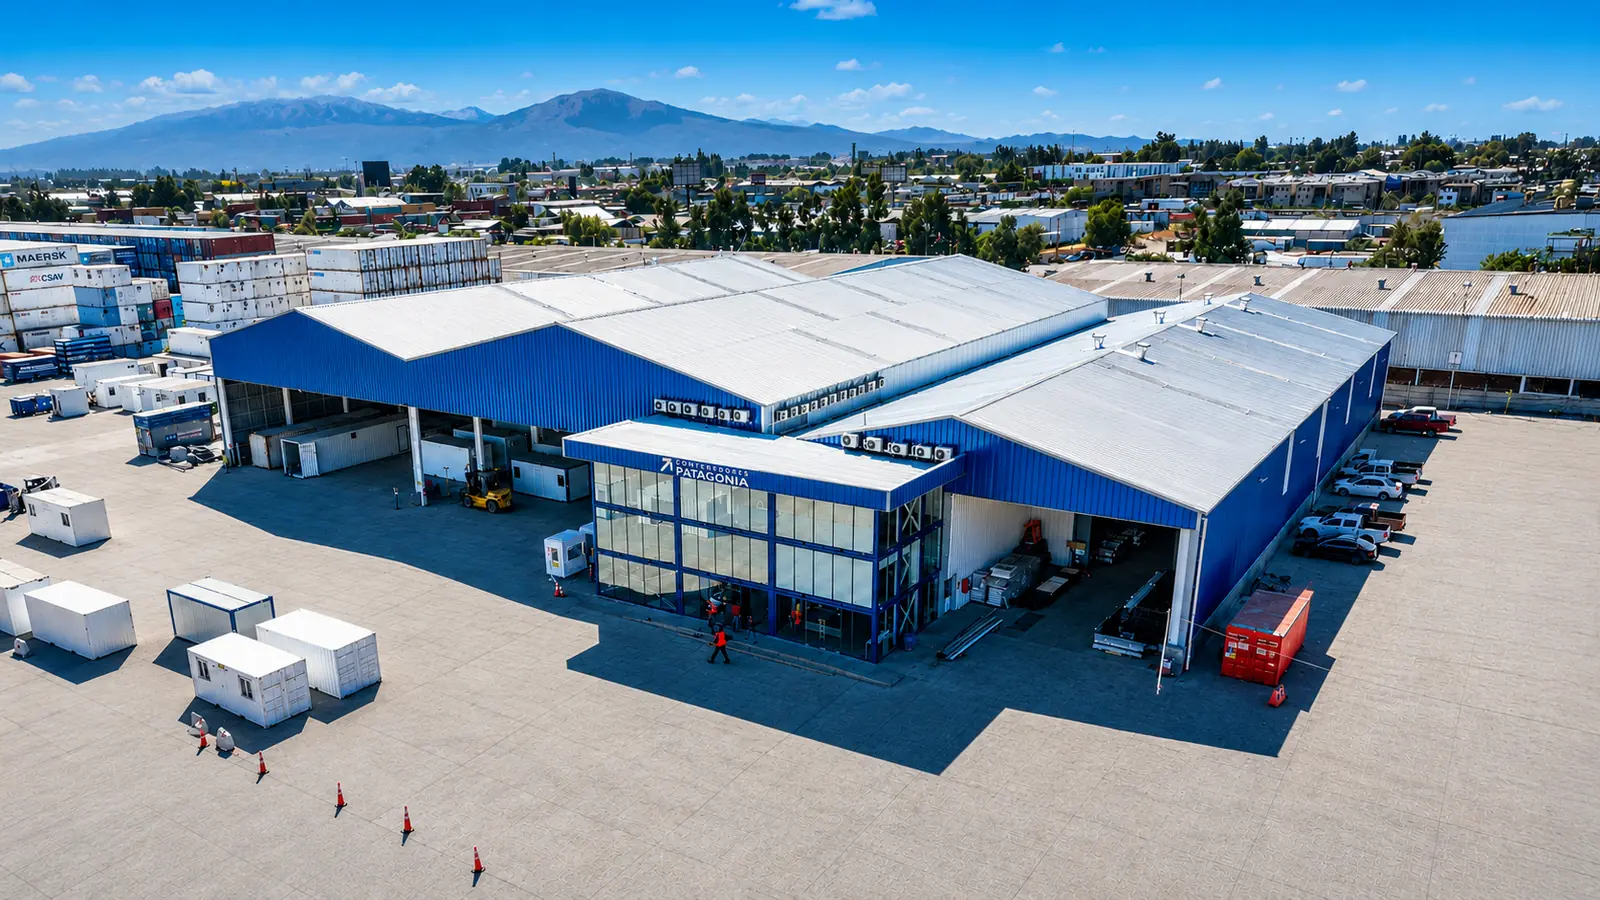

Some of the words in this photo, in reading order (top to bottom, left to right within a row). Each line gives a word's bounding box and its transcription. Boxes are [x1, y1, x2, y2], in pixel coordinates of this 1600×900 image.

[17, 251, 67, 263] MAERSK
[41, 273, 64, 282] CSAV
[676, 466, 749, 488] PATAGONIA
